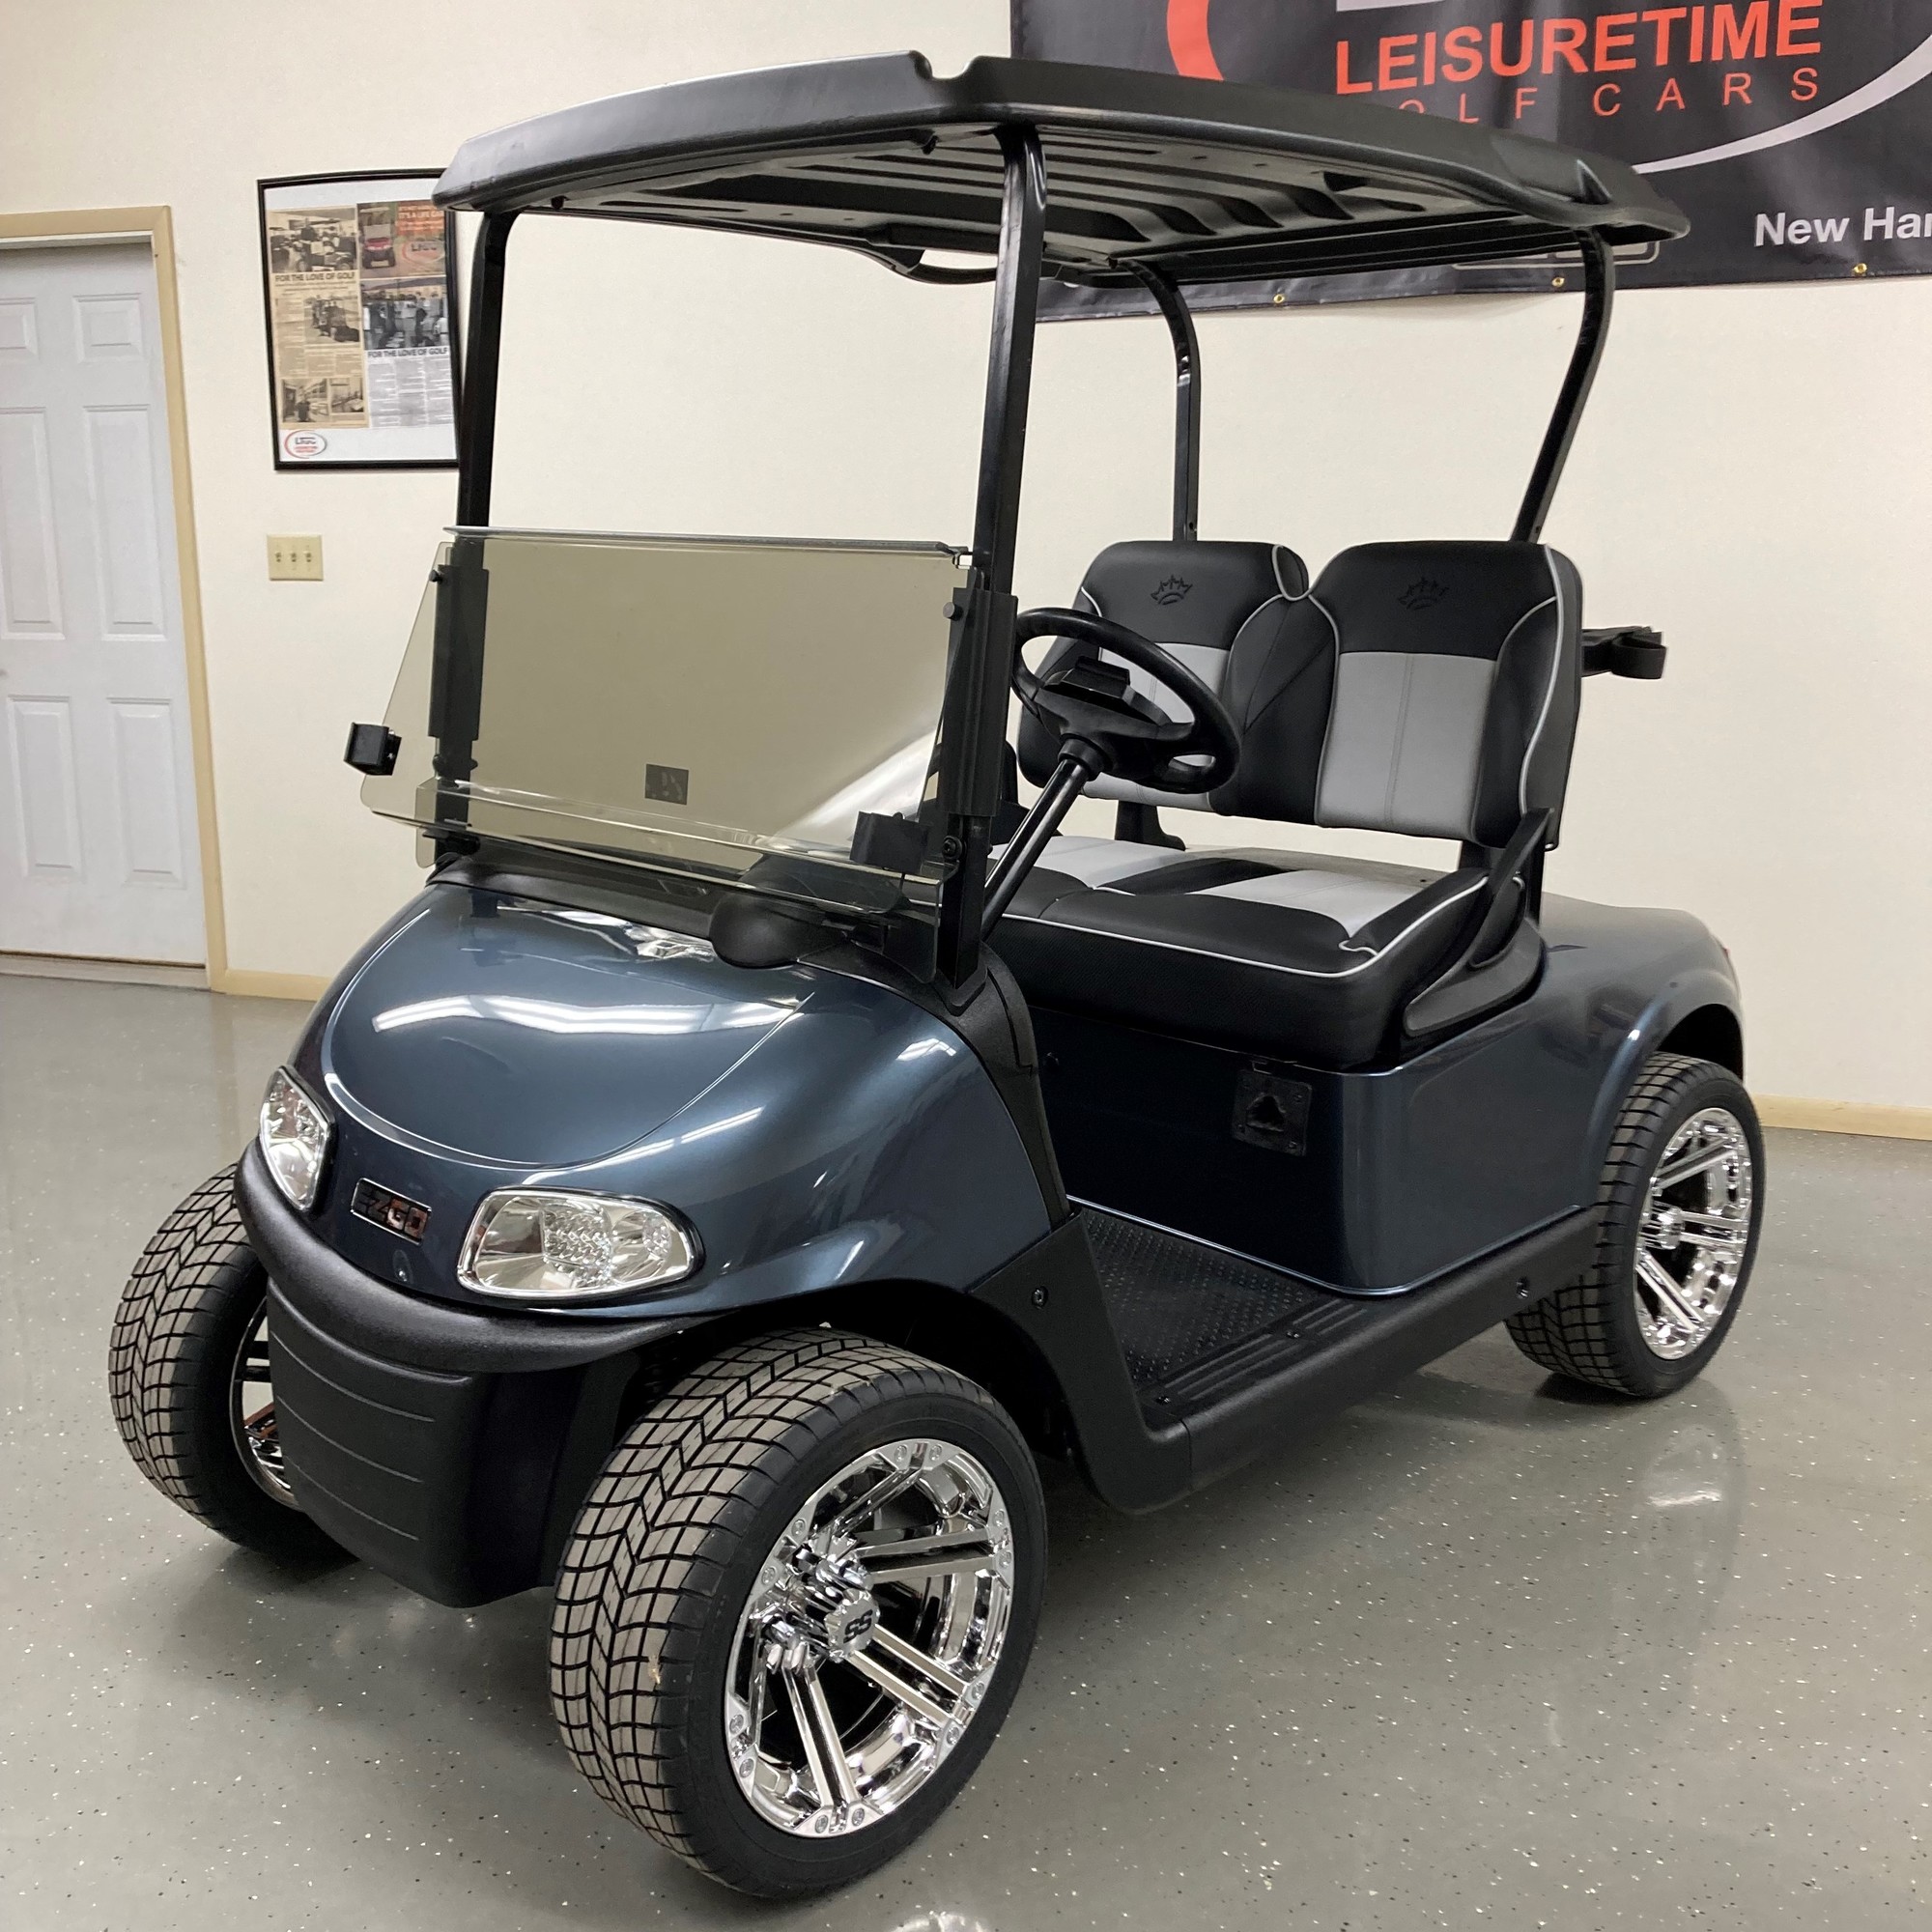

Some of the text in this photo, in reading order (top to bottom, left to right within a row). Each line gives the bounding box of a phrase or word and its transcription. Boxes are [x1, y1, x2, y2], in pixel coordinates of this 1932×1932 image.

[1336, 0, 1824, 95] LEISURETIME
[1593, 67, 1819, 117] CARS
[1754, 212, 1851, 247] New
